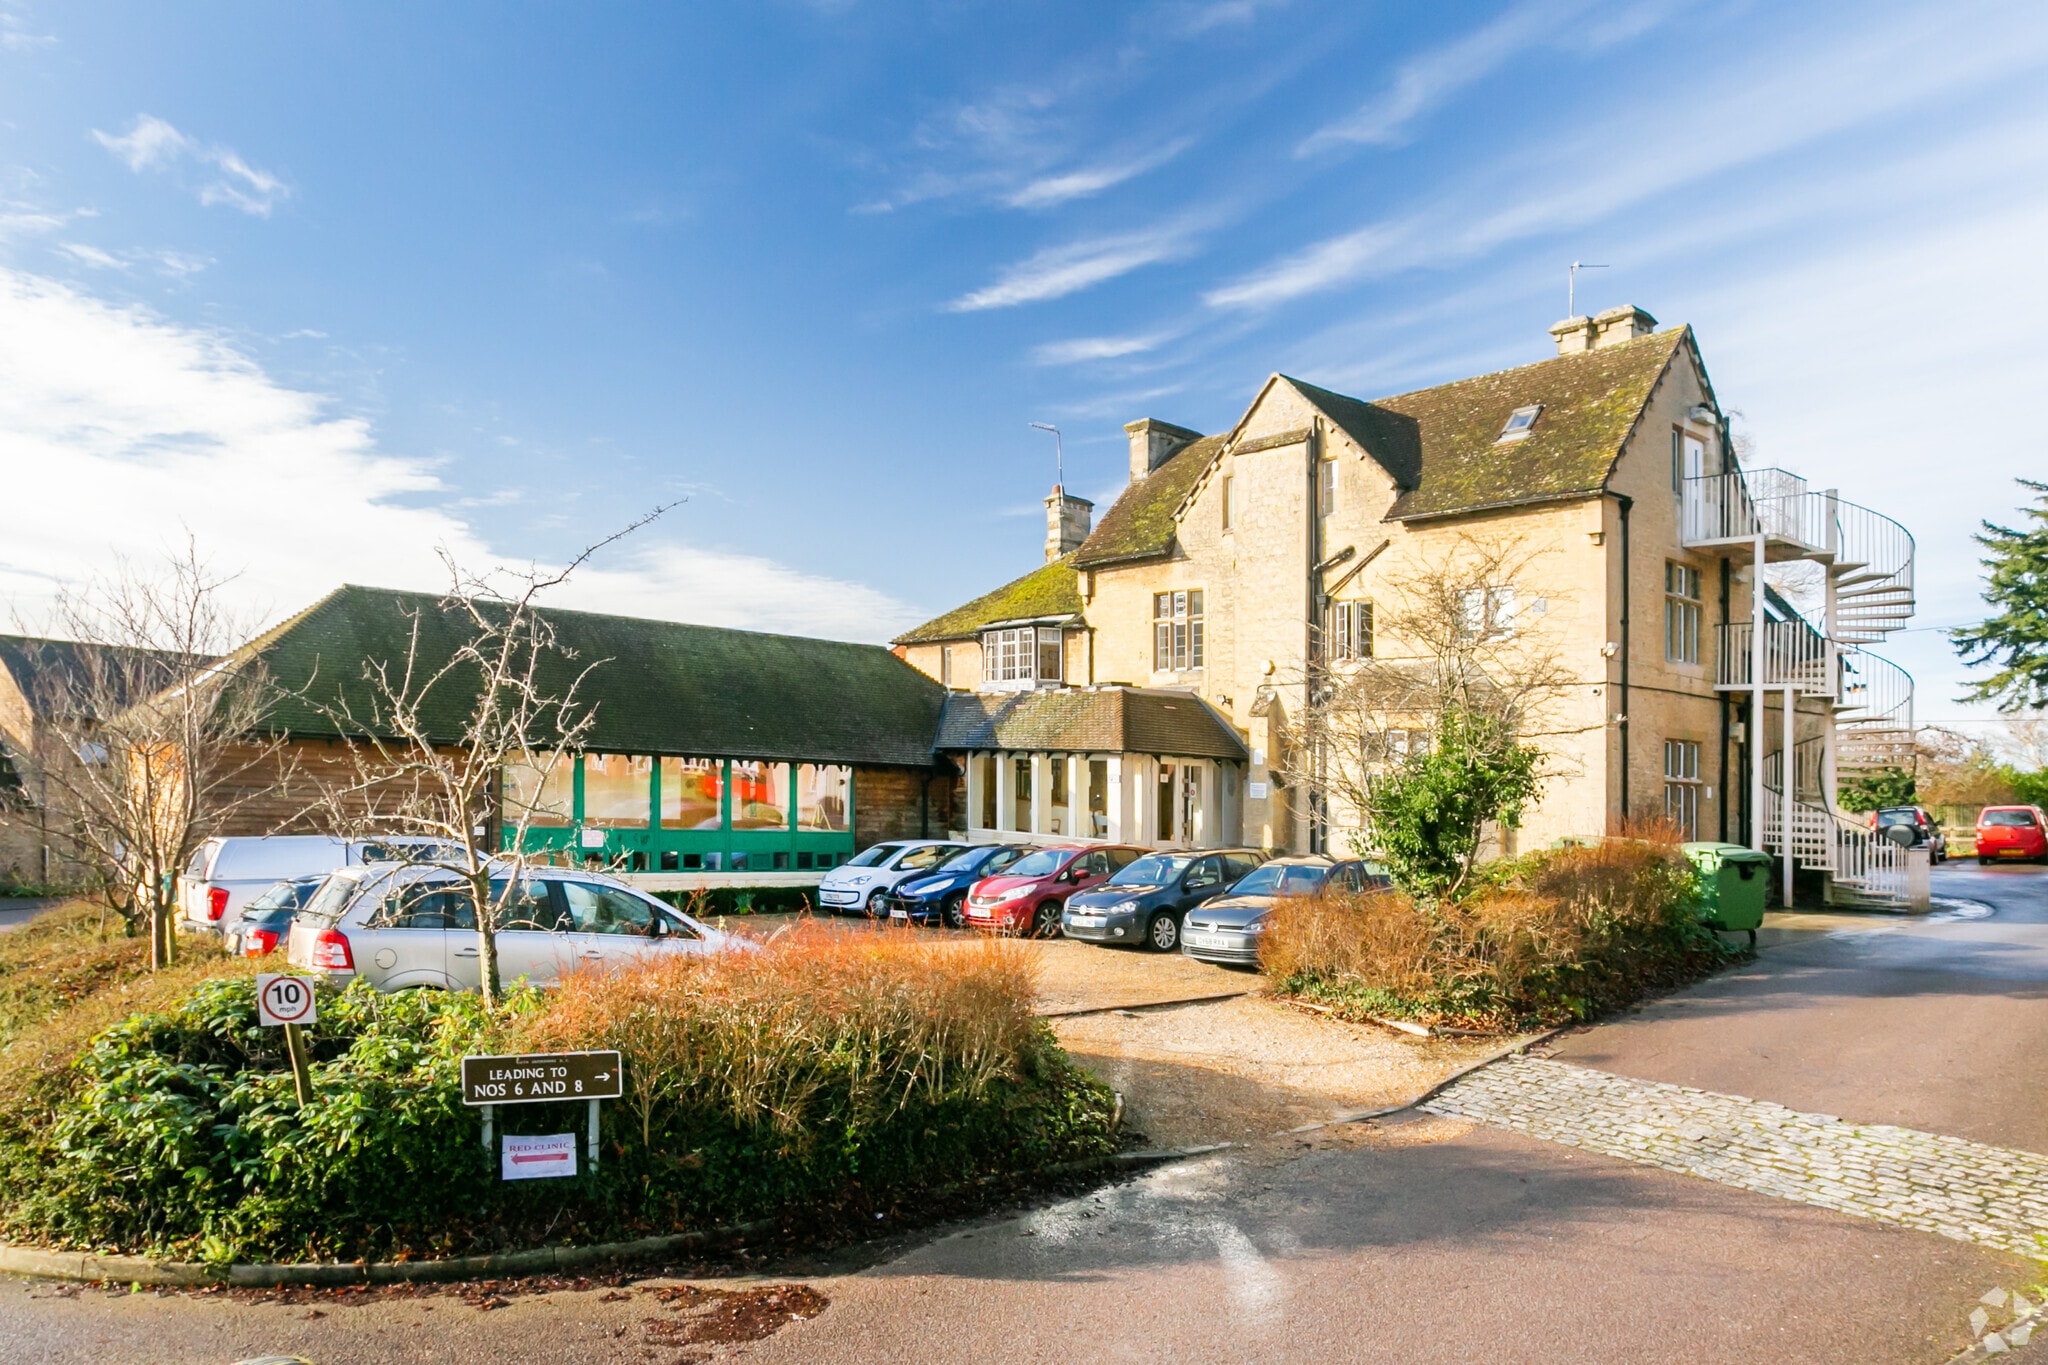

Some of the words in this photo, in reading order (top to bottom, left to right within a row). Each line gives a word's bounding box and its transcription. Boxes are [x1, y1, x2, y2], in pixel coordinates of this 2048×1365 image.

[271, 984, 300, 1004] 10
[489, 1067, 545, 1081] LEADING
[550, 1066, 568, 1078] TO
[474, 1083, 507, 1098] NOS
[514, 1082, 523, 1096] 6
[530, 1080, 567, 1095] AND
[574, 1079, 583, 1093] 8
[509, 1144, 532, 1152] RED
[534, 1142, 570, 1151] CLINIC
